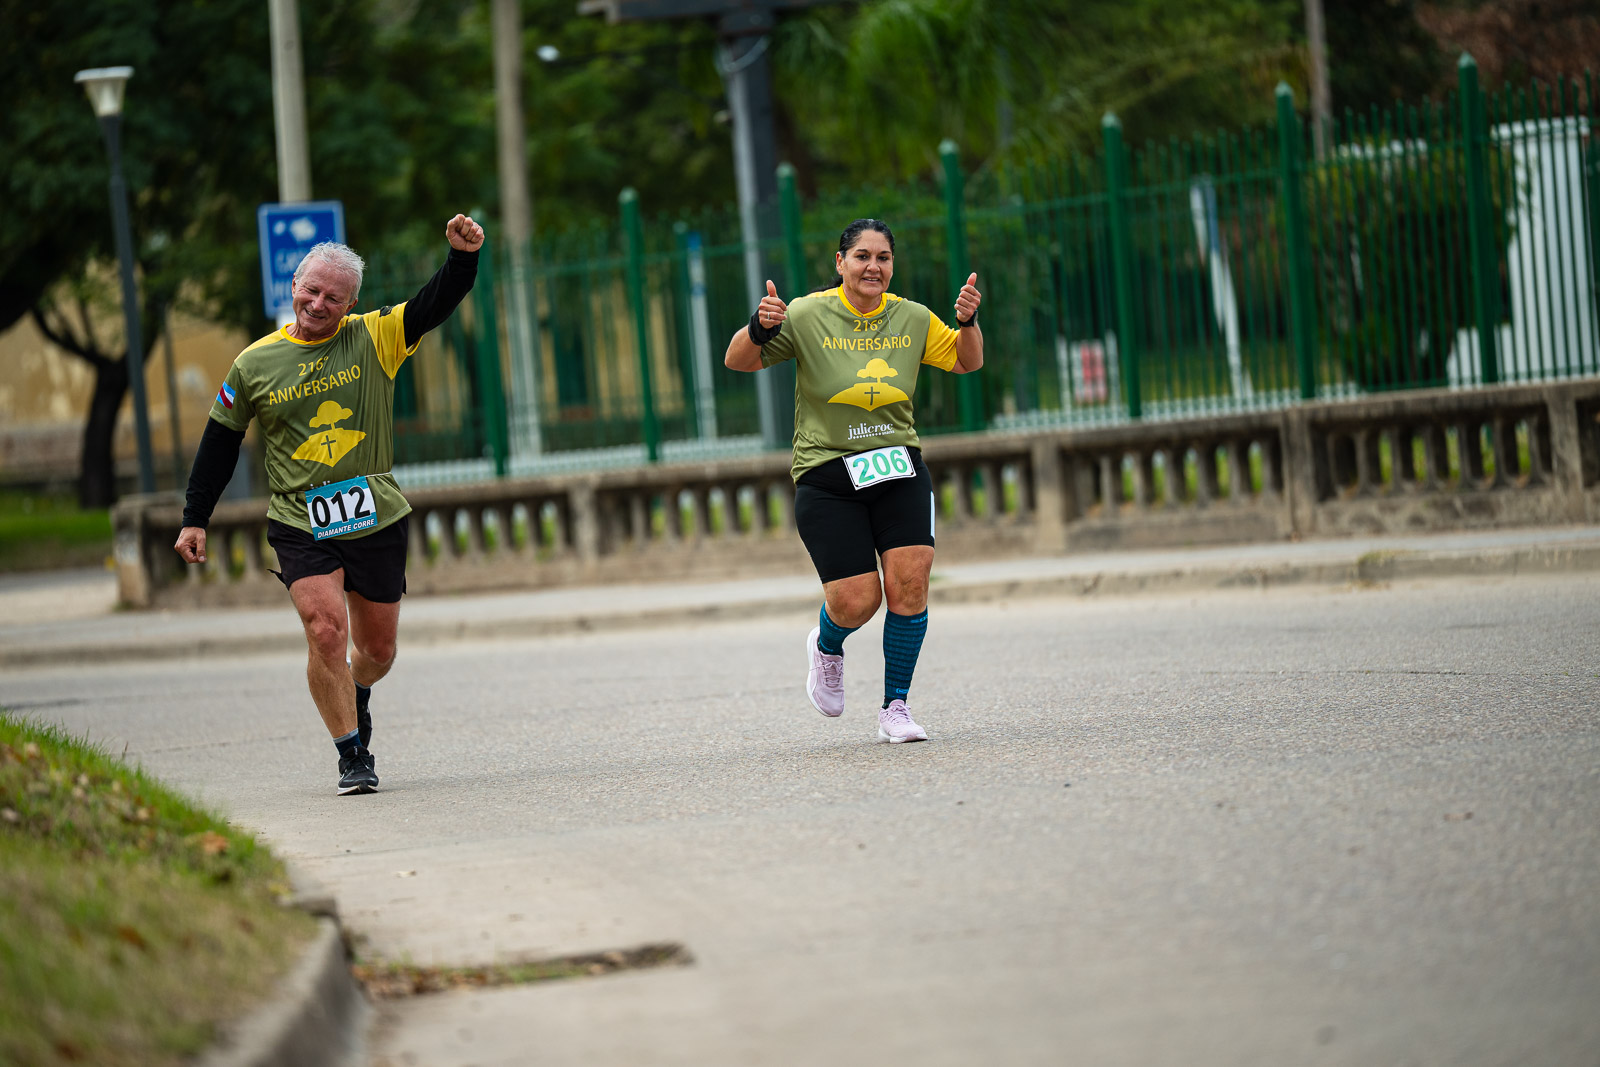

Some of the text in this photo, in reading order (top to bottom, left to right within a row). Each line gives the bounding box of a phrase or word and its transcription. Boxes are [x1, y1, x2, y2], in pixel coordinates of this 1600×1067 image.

[822, 334, 912, 351] ANIVERSARIO
[269, 364, 361, 406] ANIVERSARIO
[847, 422, 894, 440] julicroc
[852, 449, 908, 484] 206
[311, 486, 371, 528] 012
[317, 518, 375, 539] DIAMANTE CORRE
